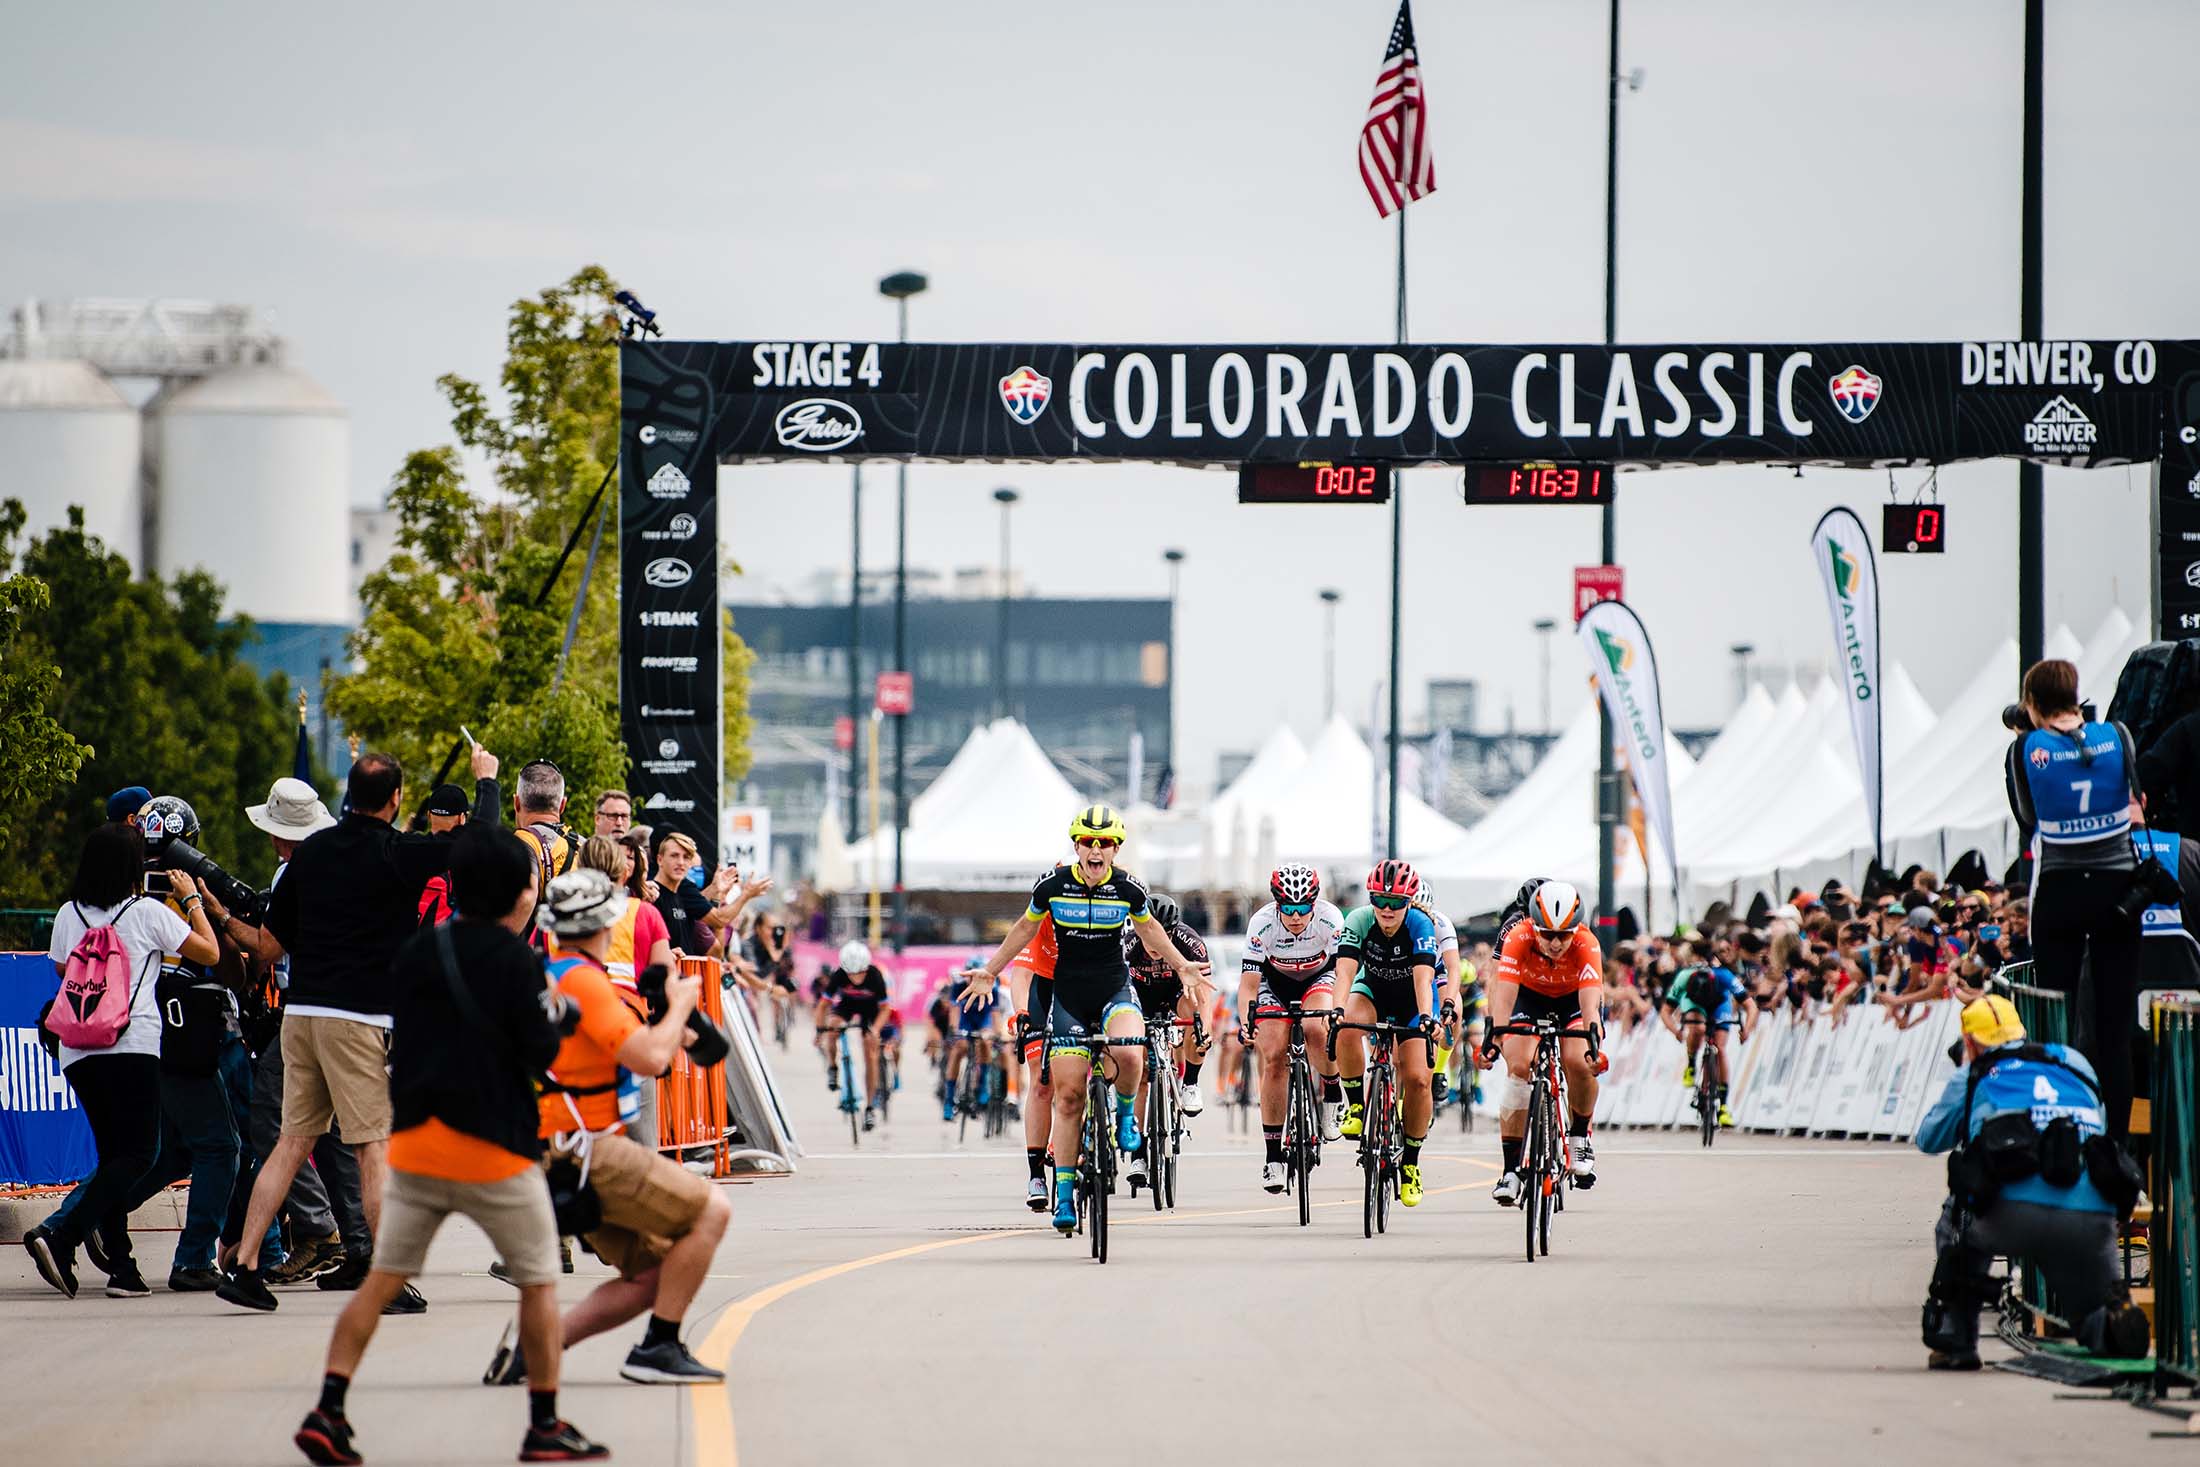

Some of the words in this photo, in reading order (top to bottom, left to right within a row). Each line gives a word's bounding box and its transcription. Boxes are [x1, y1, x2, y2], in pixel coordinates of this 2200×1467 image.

[753, 343, 851, 387] STAGE
[858, 343, 882, 387] 4
[1962, 341, 2104, 393] DENVER,
[2114, 341, 2156, 384] CO
[1069, 353, 1474, 438] COLORADO
[1511, 353, 1813, 438] CLASSIC
[782, 402, 859, 443] Gates
[2025, 423, 2097, 443] DENVER
[1315, 467, 1375, 495] 0:02
[1510, 469, 1599, 497] 1:16:31
[1916, 510, 1939, 543] 0
[1842, 603, 1872, 701] Antero
[1614, 672, 1657, 761] Antero
[2070, 779, 2092, 814] 7
[2060, 814, 2116, 832] PHOTO
[1243, 962, 1260, 972] 2018
[2033, 1075, 2059, 1106] 4
